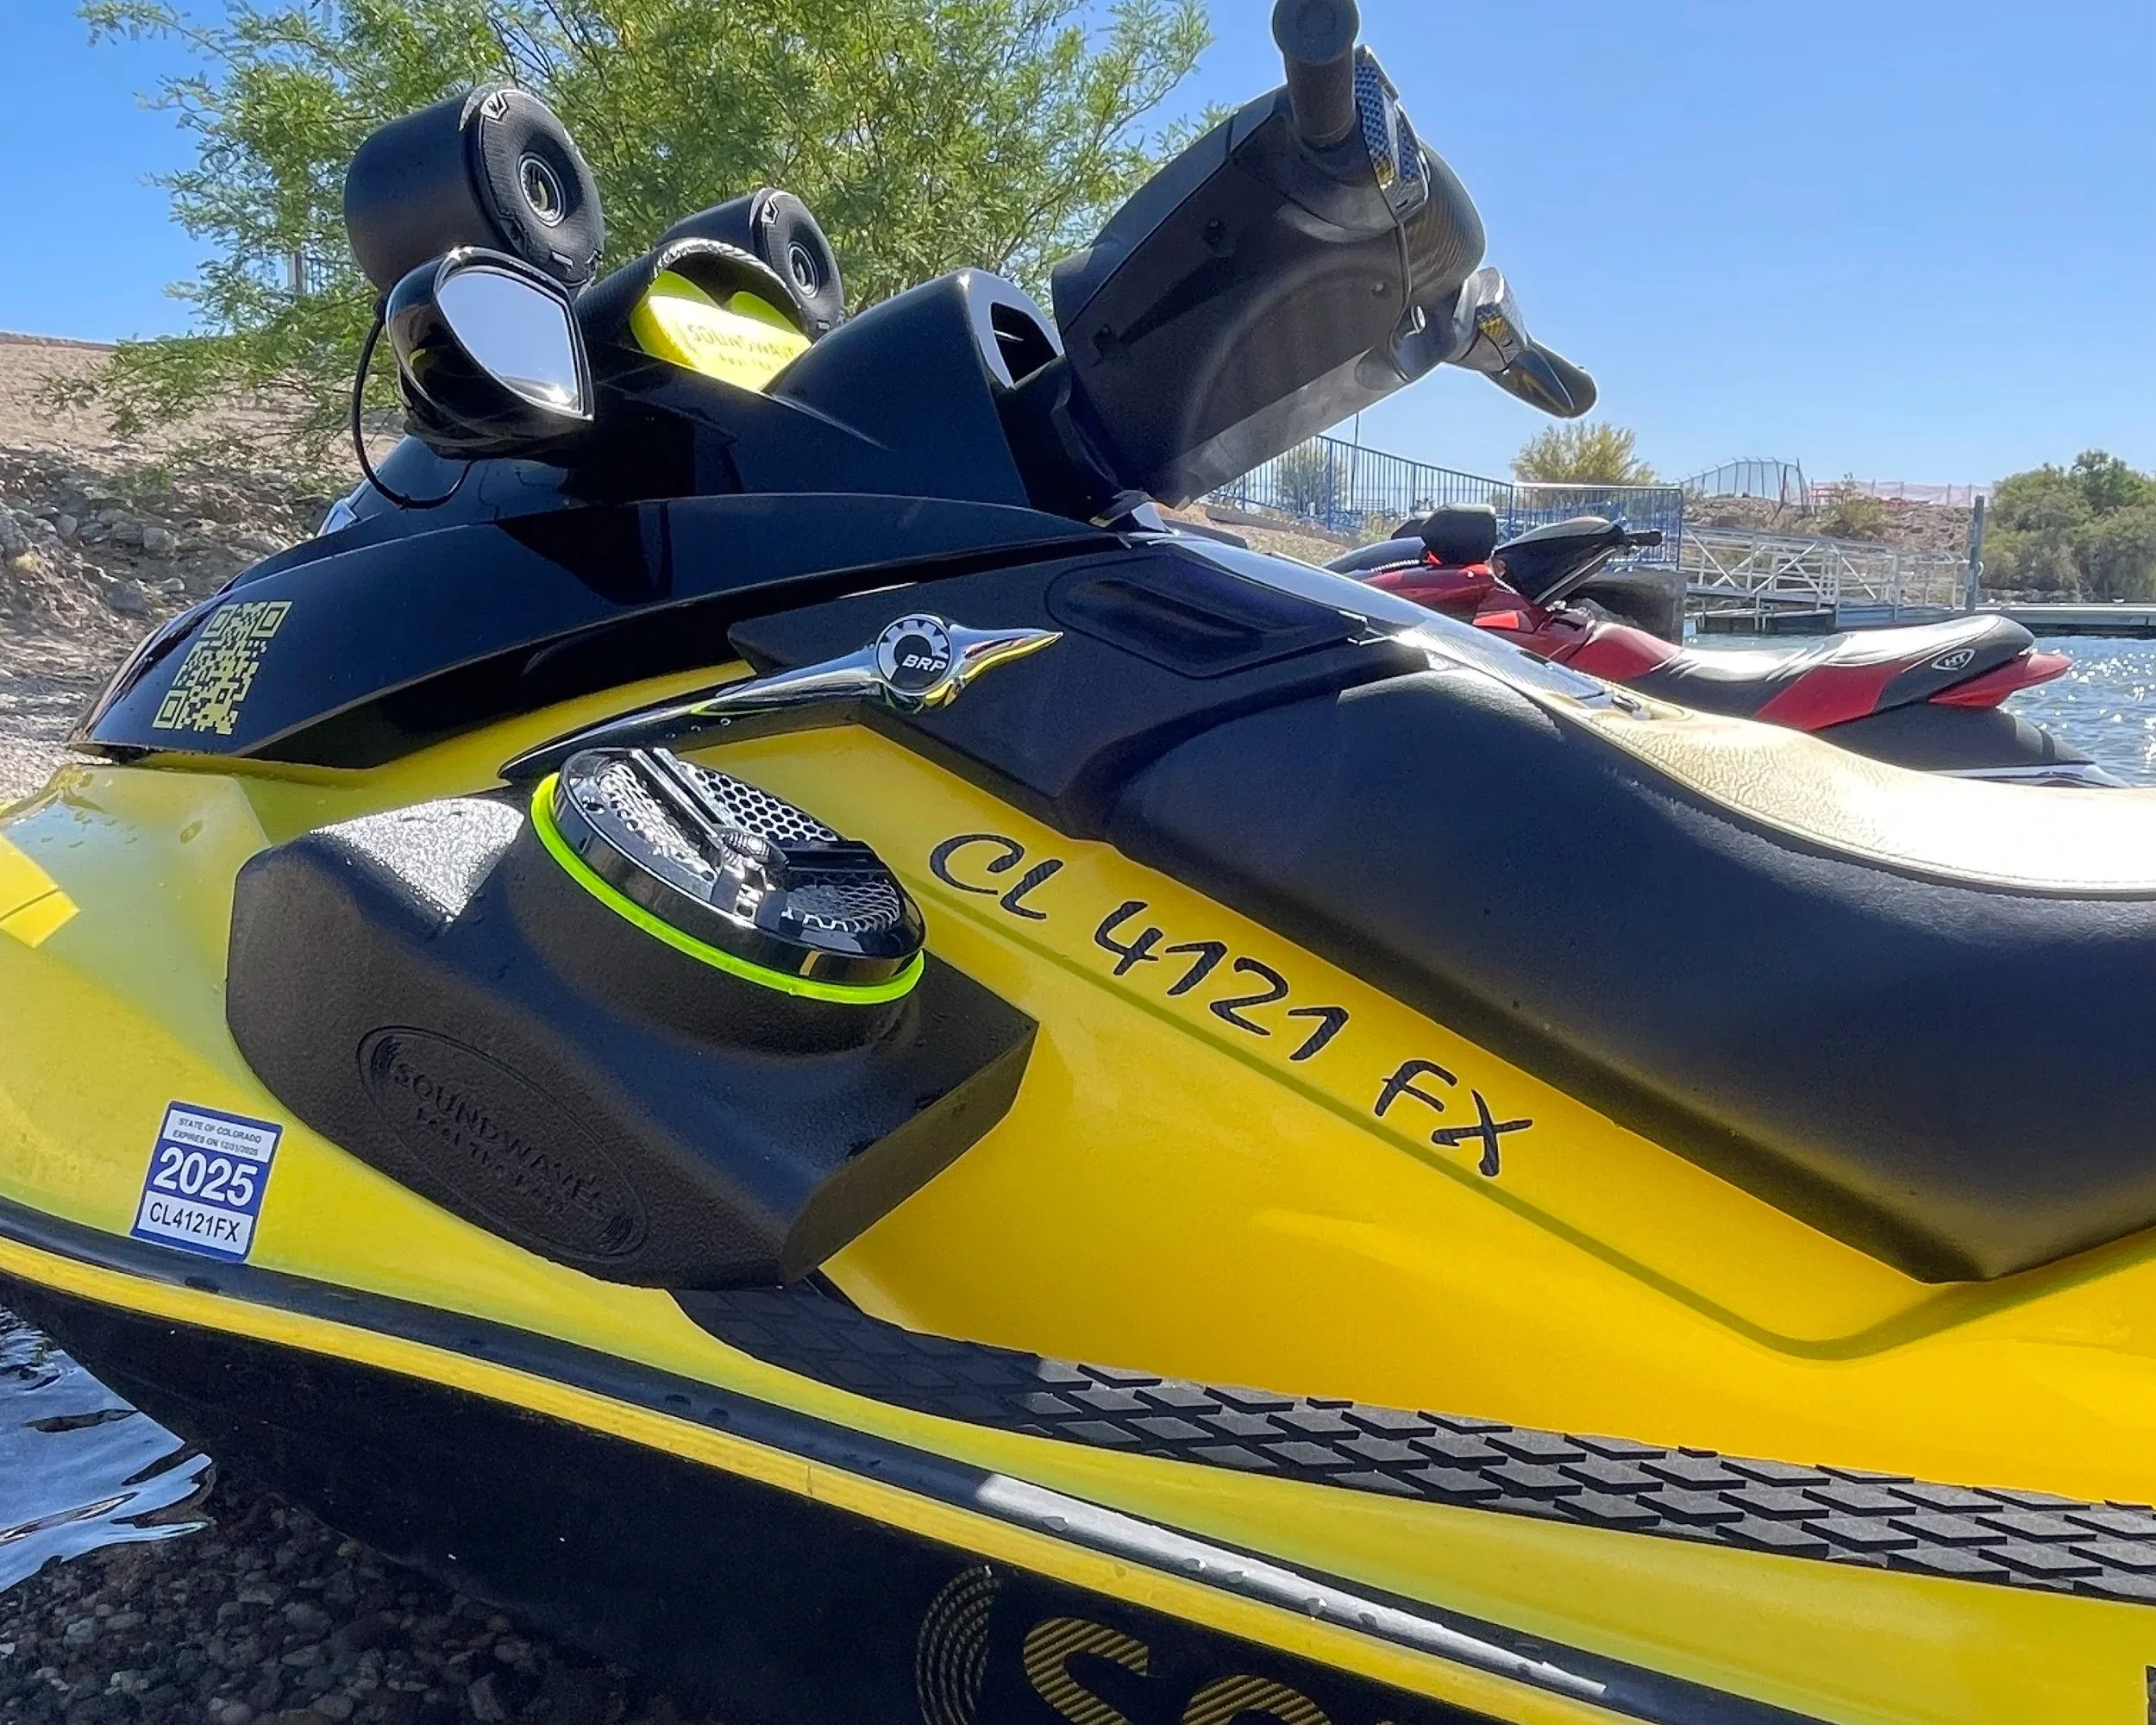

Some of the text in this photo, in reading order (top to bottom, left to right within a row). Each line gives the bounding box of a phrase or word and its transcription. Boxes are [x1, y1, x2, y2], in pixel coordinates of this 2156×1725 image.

[902, 654, 947, 672] BRP
[929, 832, 1533, 1176] CL 4121 FX
[172, 1129, 205, 1144] EXPIRES
[205, 1137, 219, 1147] ON
[179, 1117, 262, 1144] STATE OF COLORADO
[152, 1146, 259, 1207] 2025
[149, 1201, 241, 1242] CL4121FX
